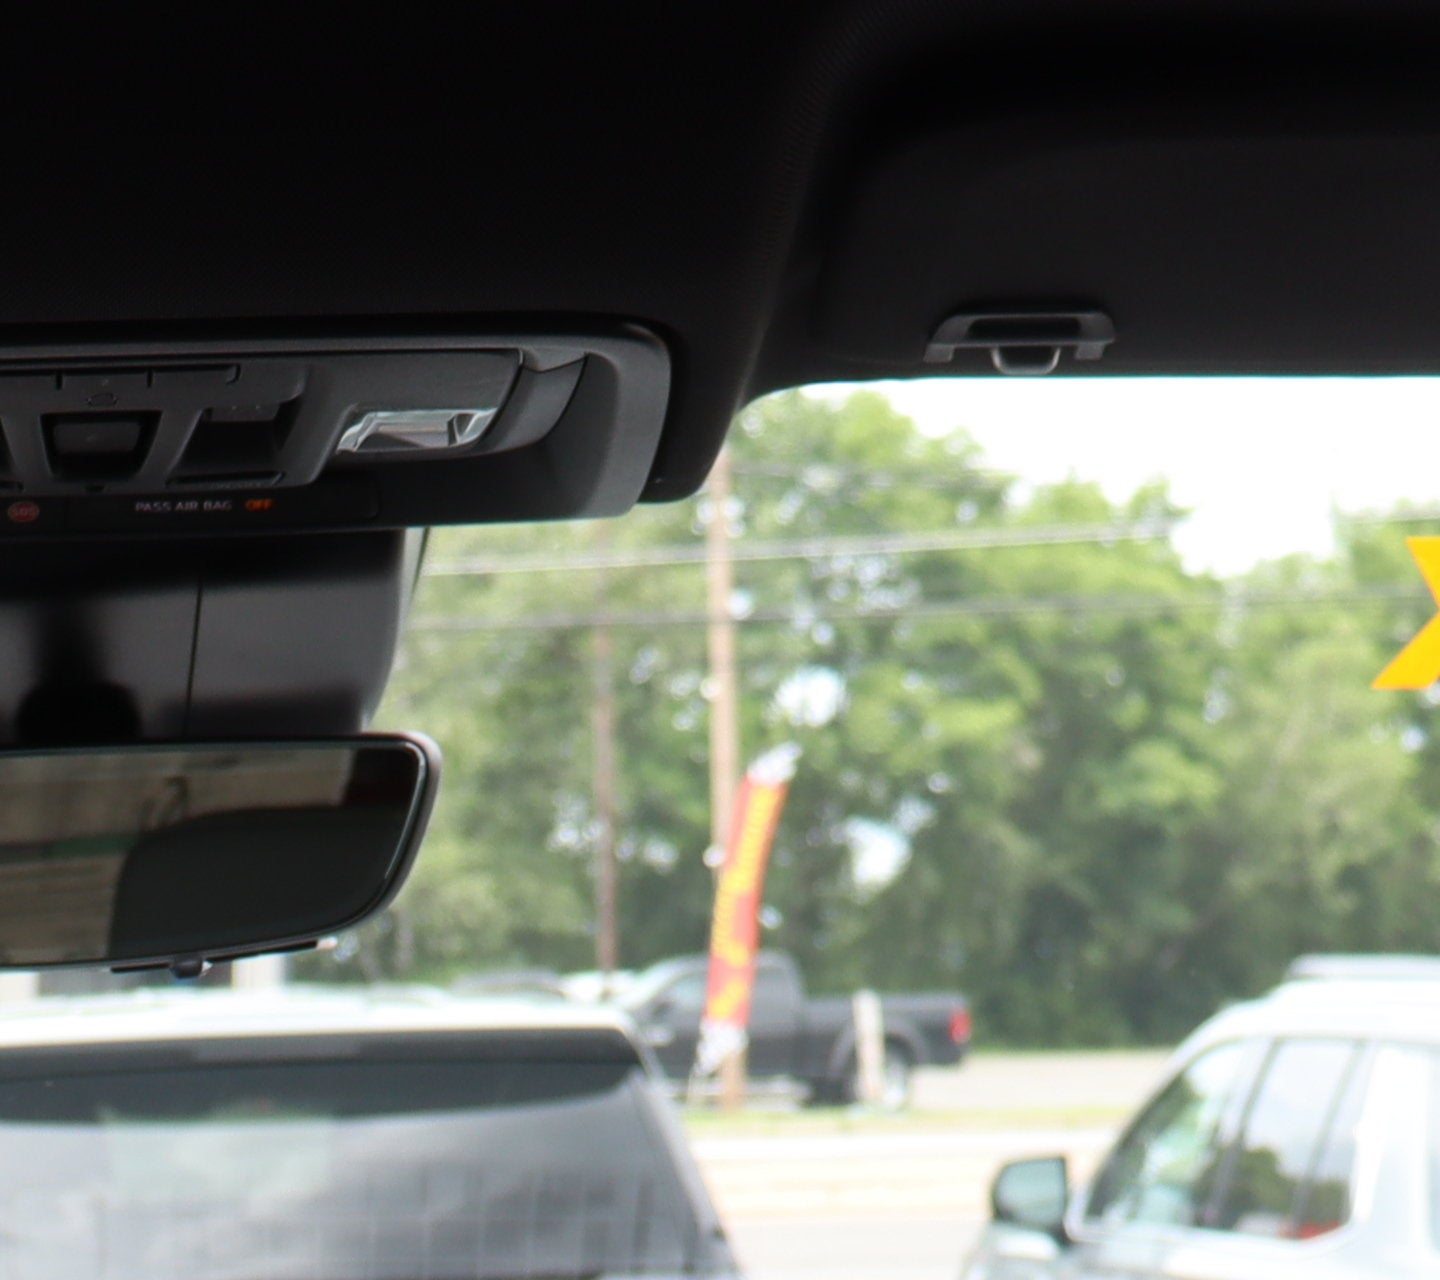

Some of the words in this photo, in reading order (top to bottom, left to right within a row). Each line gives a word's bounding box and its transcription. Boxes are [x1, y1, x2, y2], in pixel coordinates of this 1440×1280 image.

[135, 501, 172, 512] PASS
[175, 500, 199, 512] AIR
[203, 500, 233, 511] BAG
[244, 498, 273, 511] OFF
